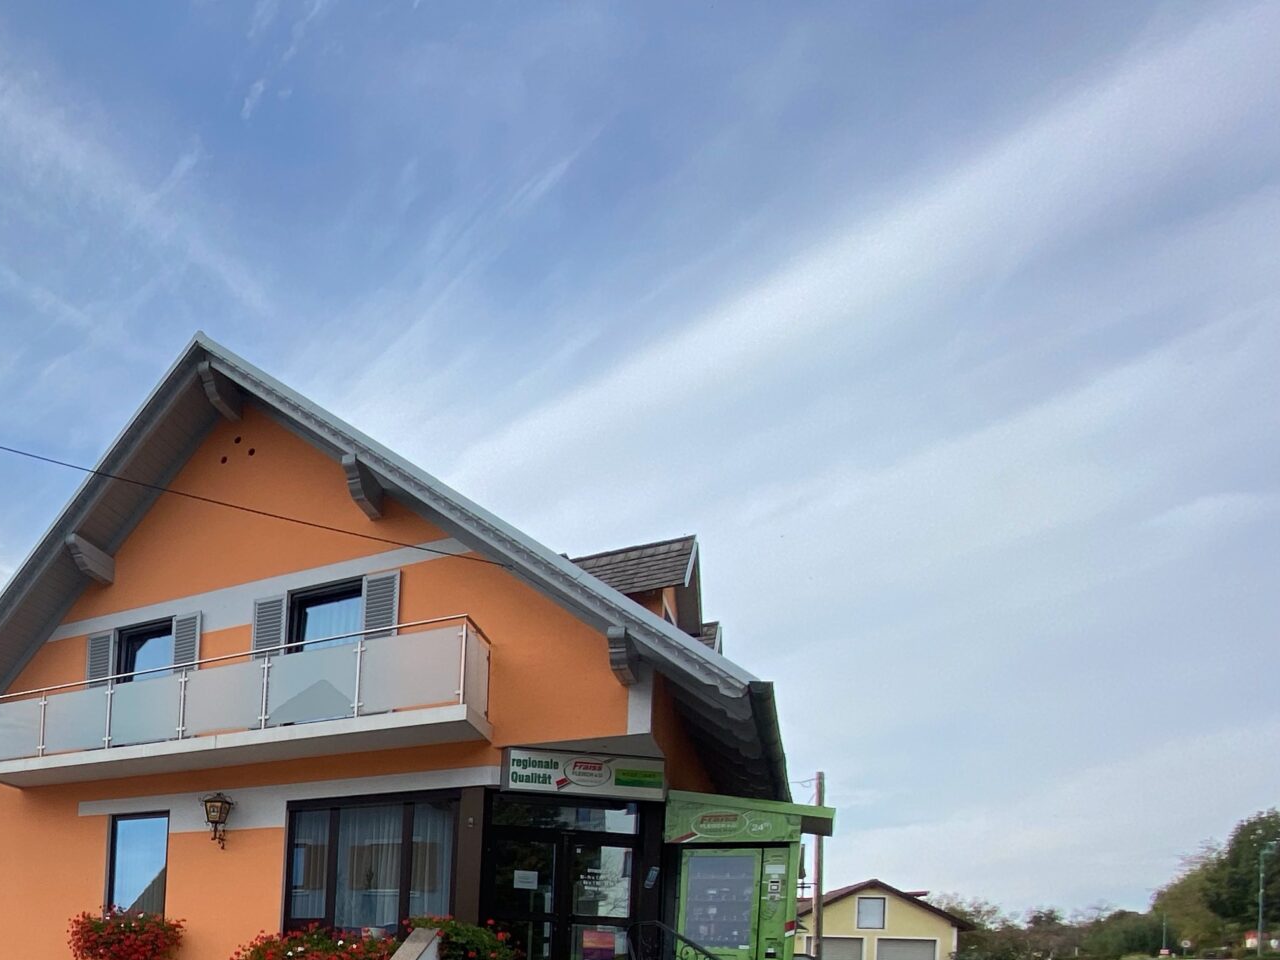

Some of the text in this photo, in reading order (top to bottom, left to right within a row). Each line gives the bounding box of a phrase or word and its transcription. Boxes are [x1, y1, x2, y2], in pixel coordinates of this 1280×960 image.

[511, 757, 559, 770] regionale
[572, 761, 603, 771] Fraiss
[511, 771, 552, 785] Qualität
